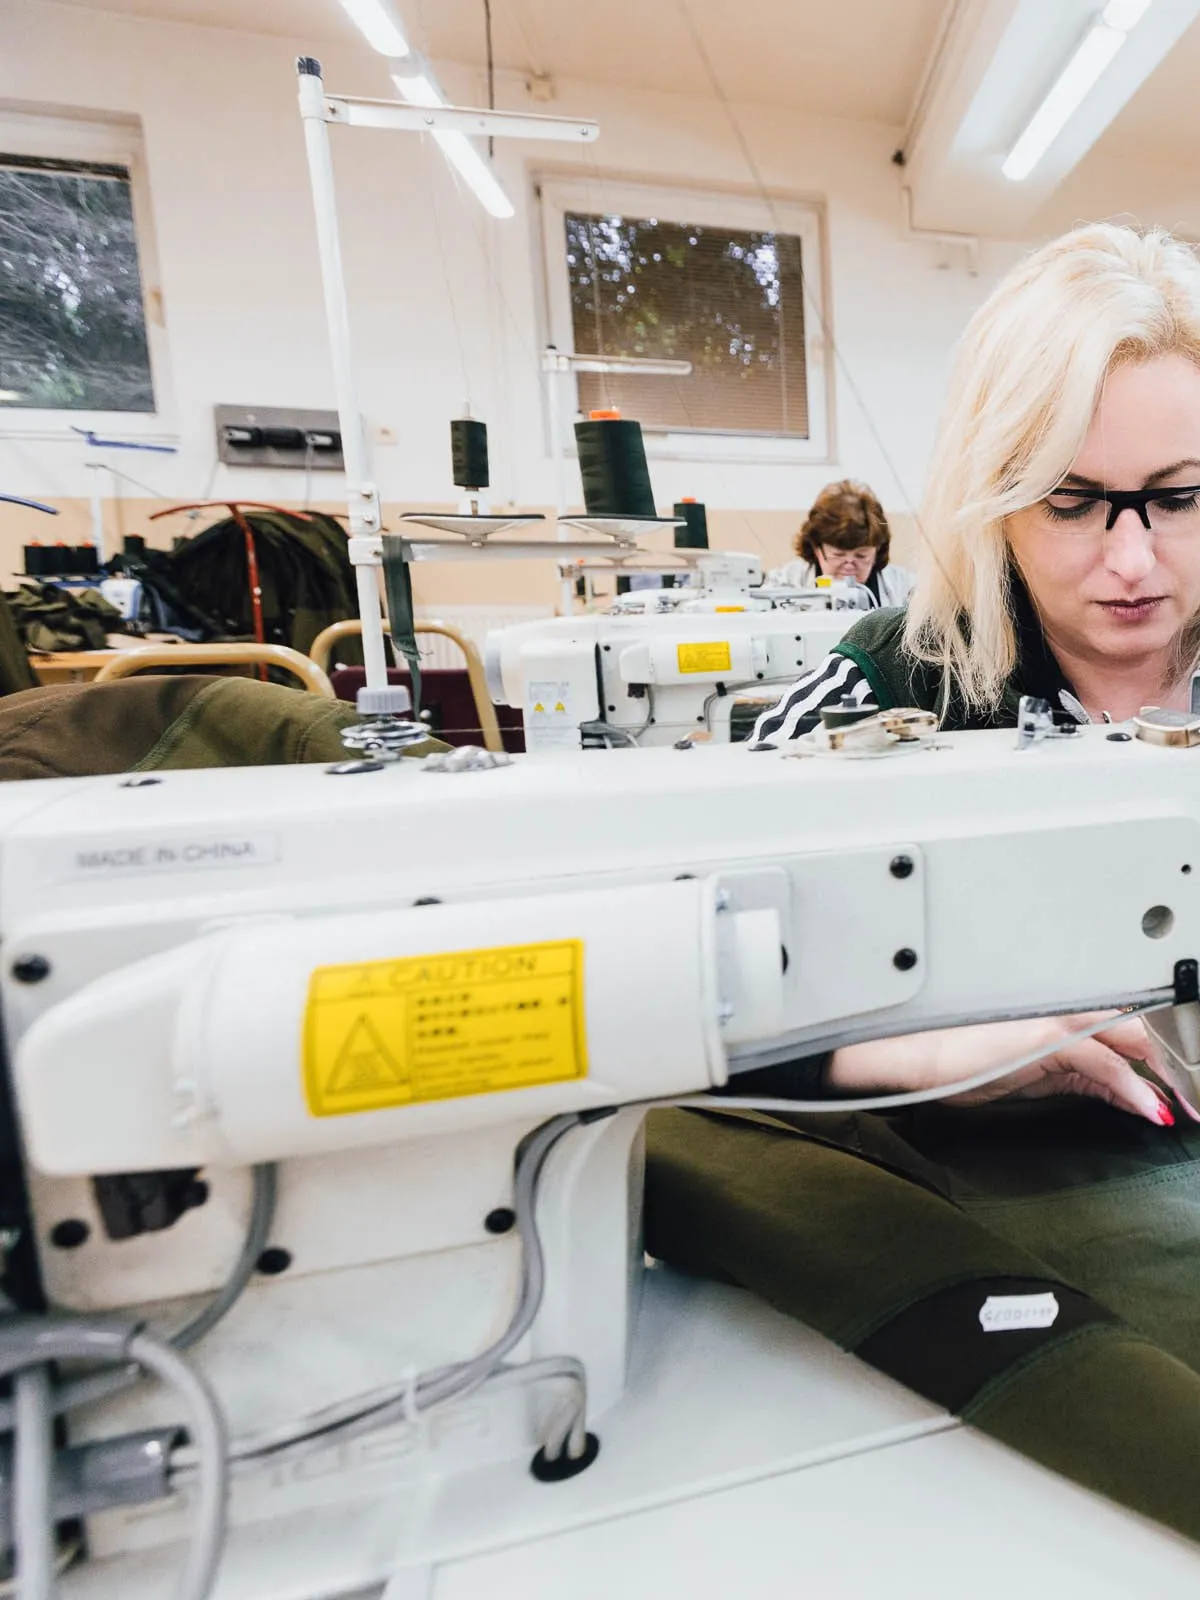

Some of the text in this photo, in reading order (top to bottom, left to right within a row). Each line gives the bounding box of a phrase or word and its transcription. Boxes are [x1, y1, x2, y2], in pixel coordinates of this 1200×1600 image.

[77, 849, 144, 868] MADE
[183, 841, 256, 862] CHINA
[388, 953, 539, 988] CAUTION
